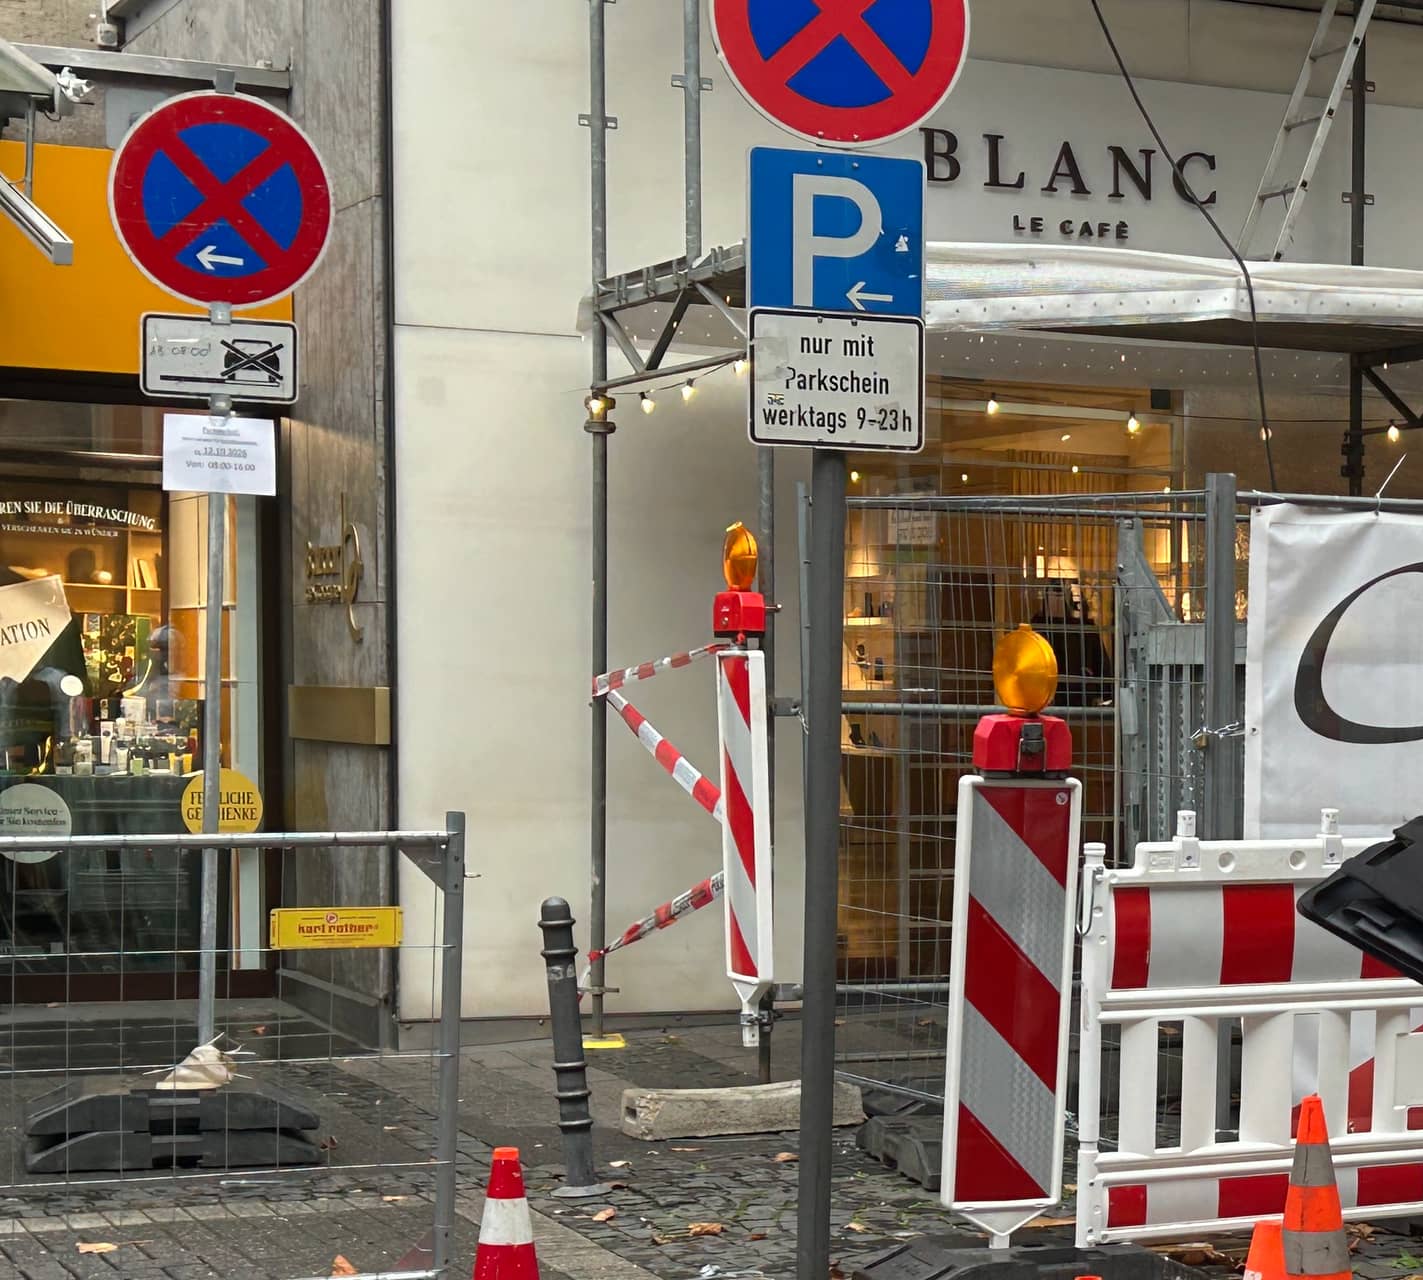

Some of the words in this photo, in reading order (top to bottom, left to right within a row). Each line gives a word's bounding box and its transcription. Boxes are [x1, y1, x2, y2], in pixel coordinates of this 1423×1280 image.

[918, 127, 1217, 206] BLANC
[1013, 214, 1044, 233] LE
[793, 173, 883, 307] P
[800, 335, 833, 355] nur
[843, 333, 875, 358] mit
[762, 403, 848, 434] werktags
[24, 501, 42, 514] SIE
[44, 501, 63, 515] DIE
